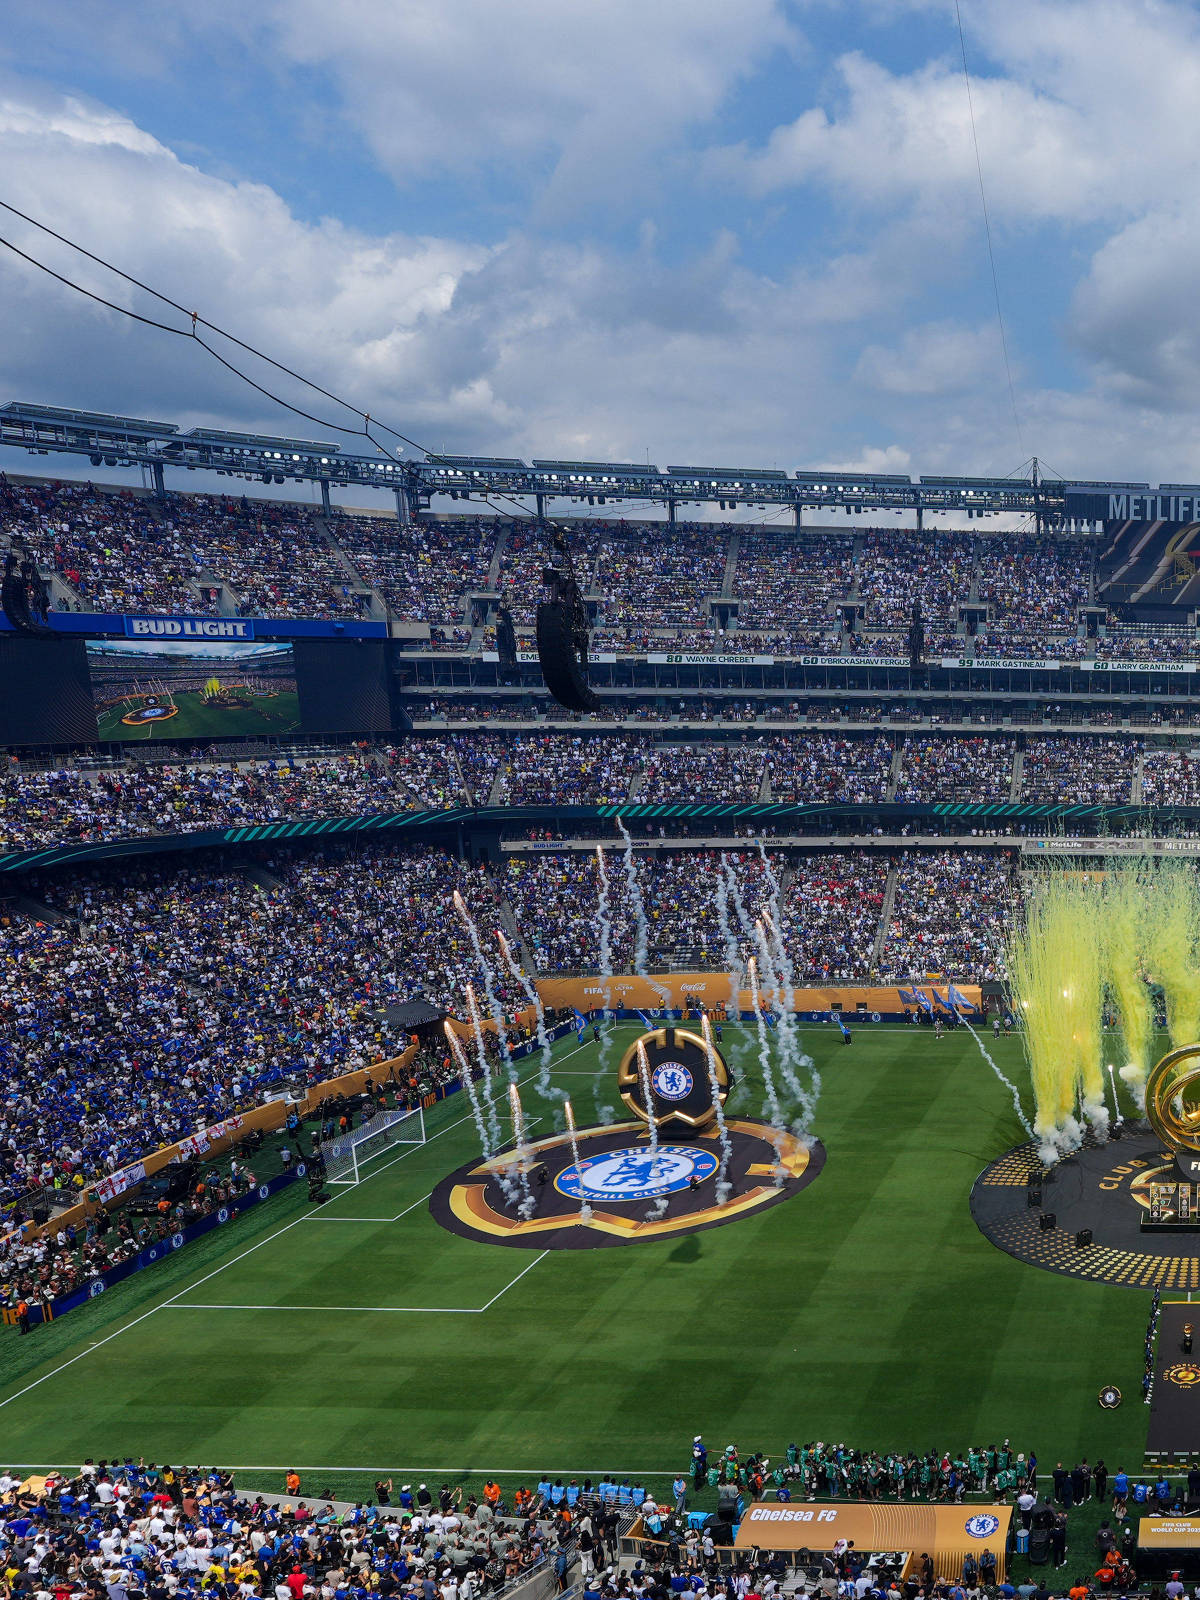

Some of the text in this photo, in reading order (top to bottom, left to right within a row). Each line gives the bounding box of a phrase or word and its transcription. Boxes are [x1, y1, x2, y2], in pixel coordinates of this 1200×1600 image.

[132, 619, 245, 636] BUD LIGHT
[1099, 1160, 1149, 1190] CLUB
[633, 1187, 670, 1197] CLUB
[750, 1509, 838, 1522] Chelsea FC
